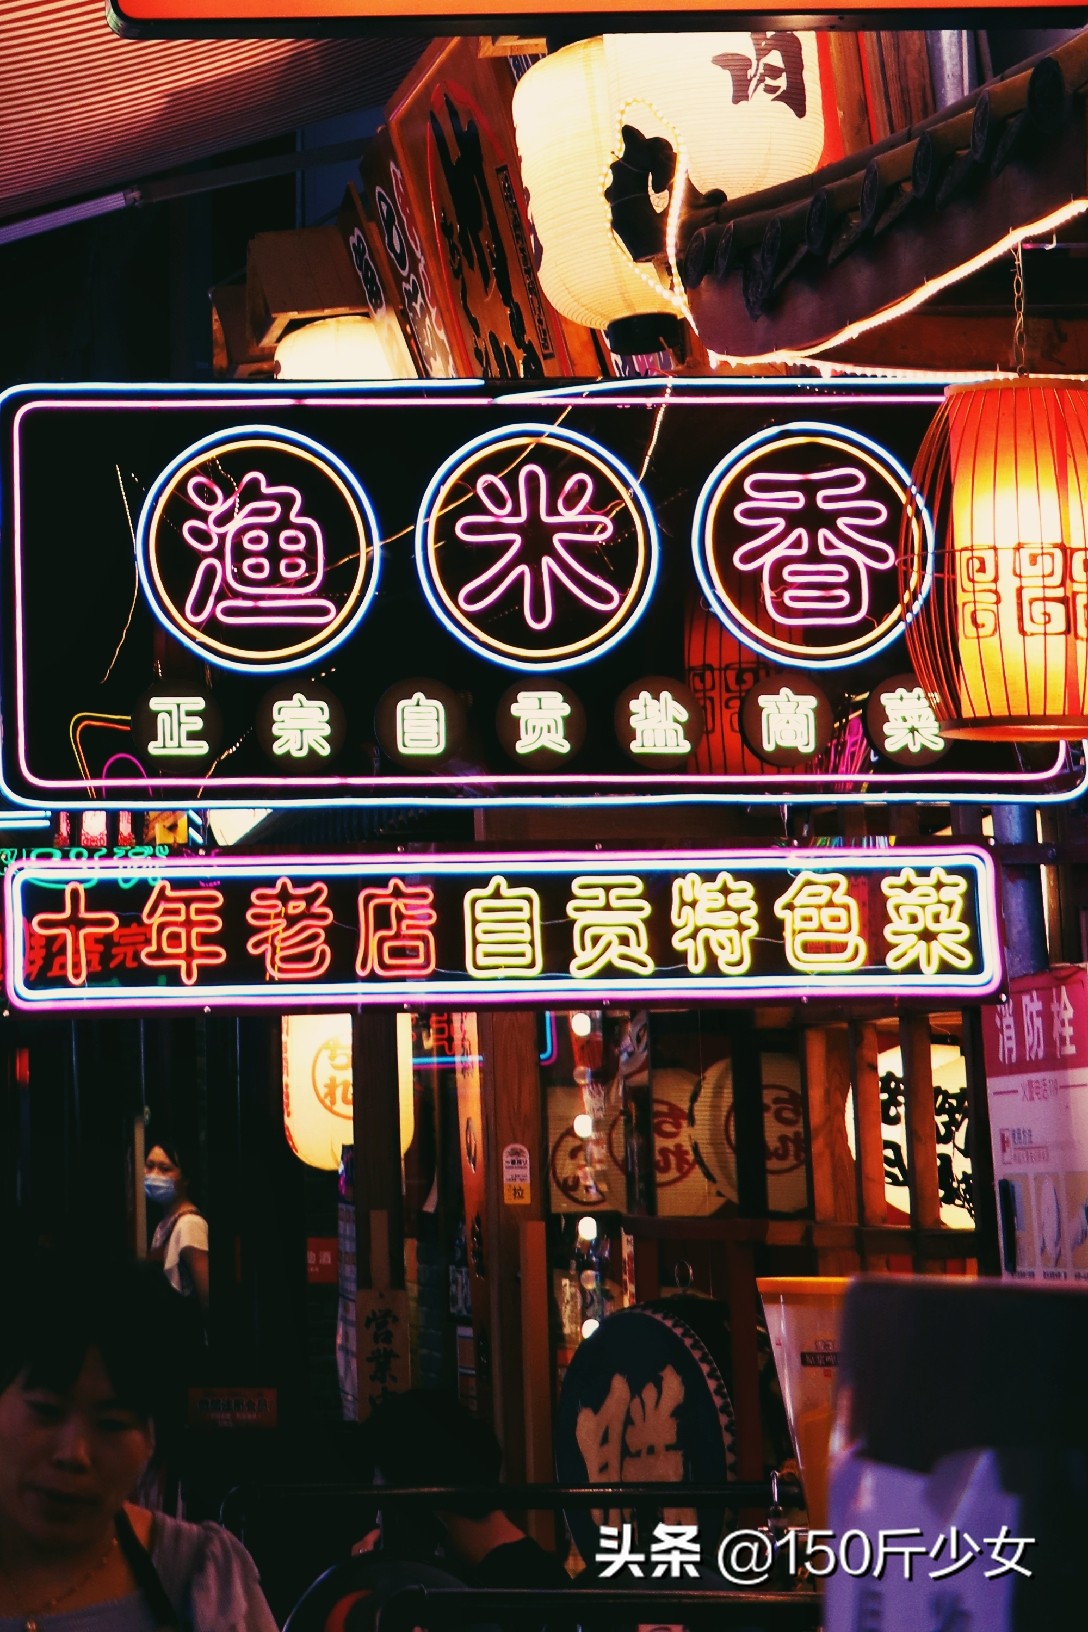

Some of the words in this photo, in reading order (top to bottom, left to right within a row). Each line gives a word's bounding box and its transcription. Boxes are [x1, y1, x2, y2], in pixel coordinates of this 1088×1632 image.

[183, 464, 895, 630] 渔米香
[146, 687, 945, 759] 正宗自贡盐商菜
[31, 866, 972, 986] 十年老店自贡特色菜
[995, 985, 1077, 1065] 消防栓
